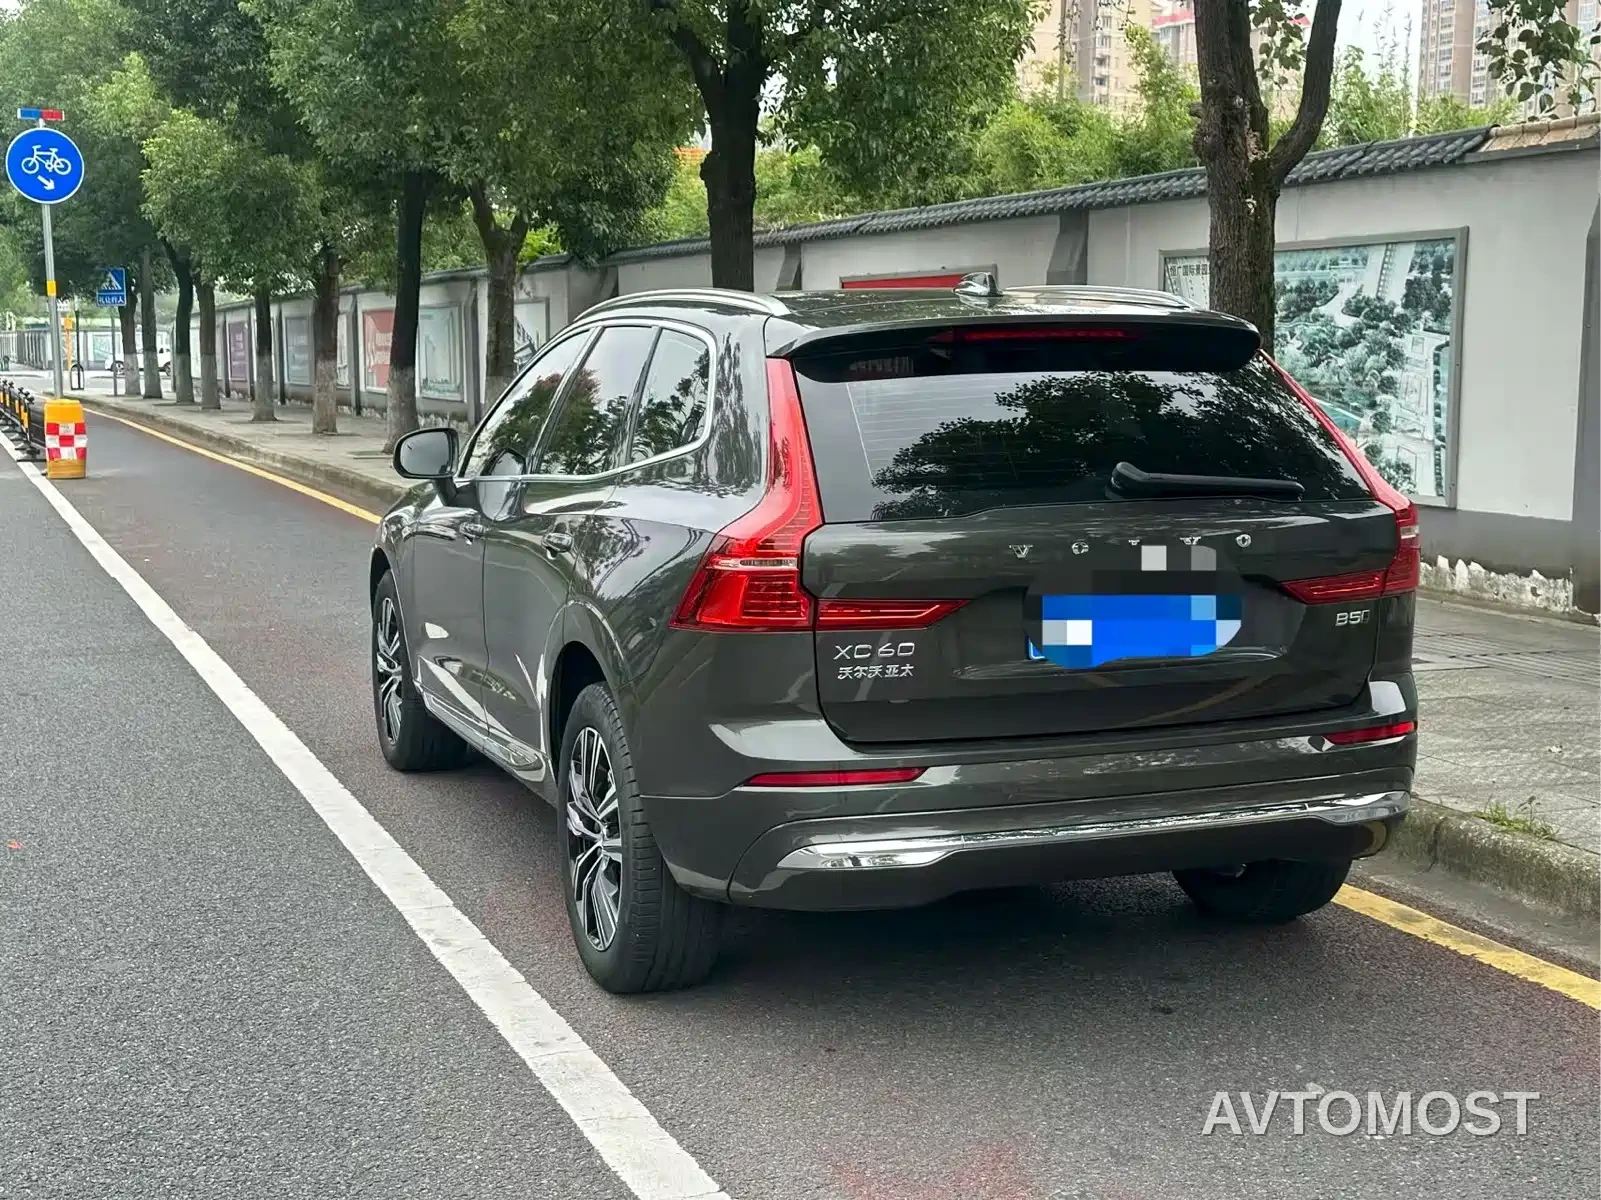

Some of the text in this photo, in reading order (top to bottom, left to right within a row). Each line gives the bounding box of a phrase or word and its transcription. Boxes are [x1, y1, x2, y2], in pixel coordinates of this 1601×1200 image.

[837, 663, 915, 680] 沃尔沃亚太
